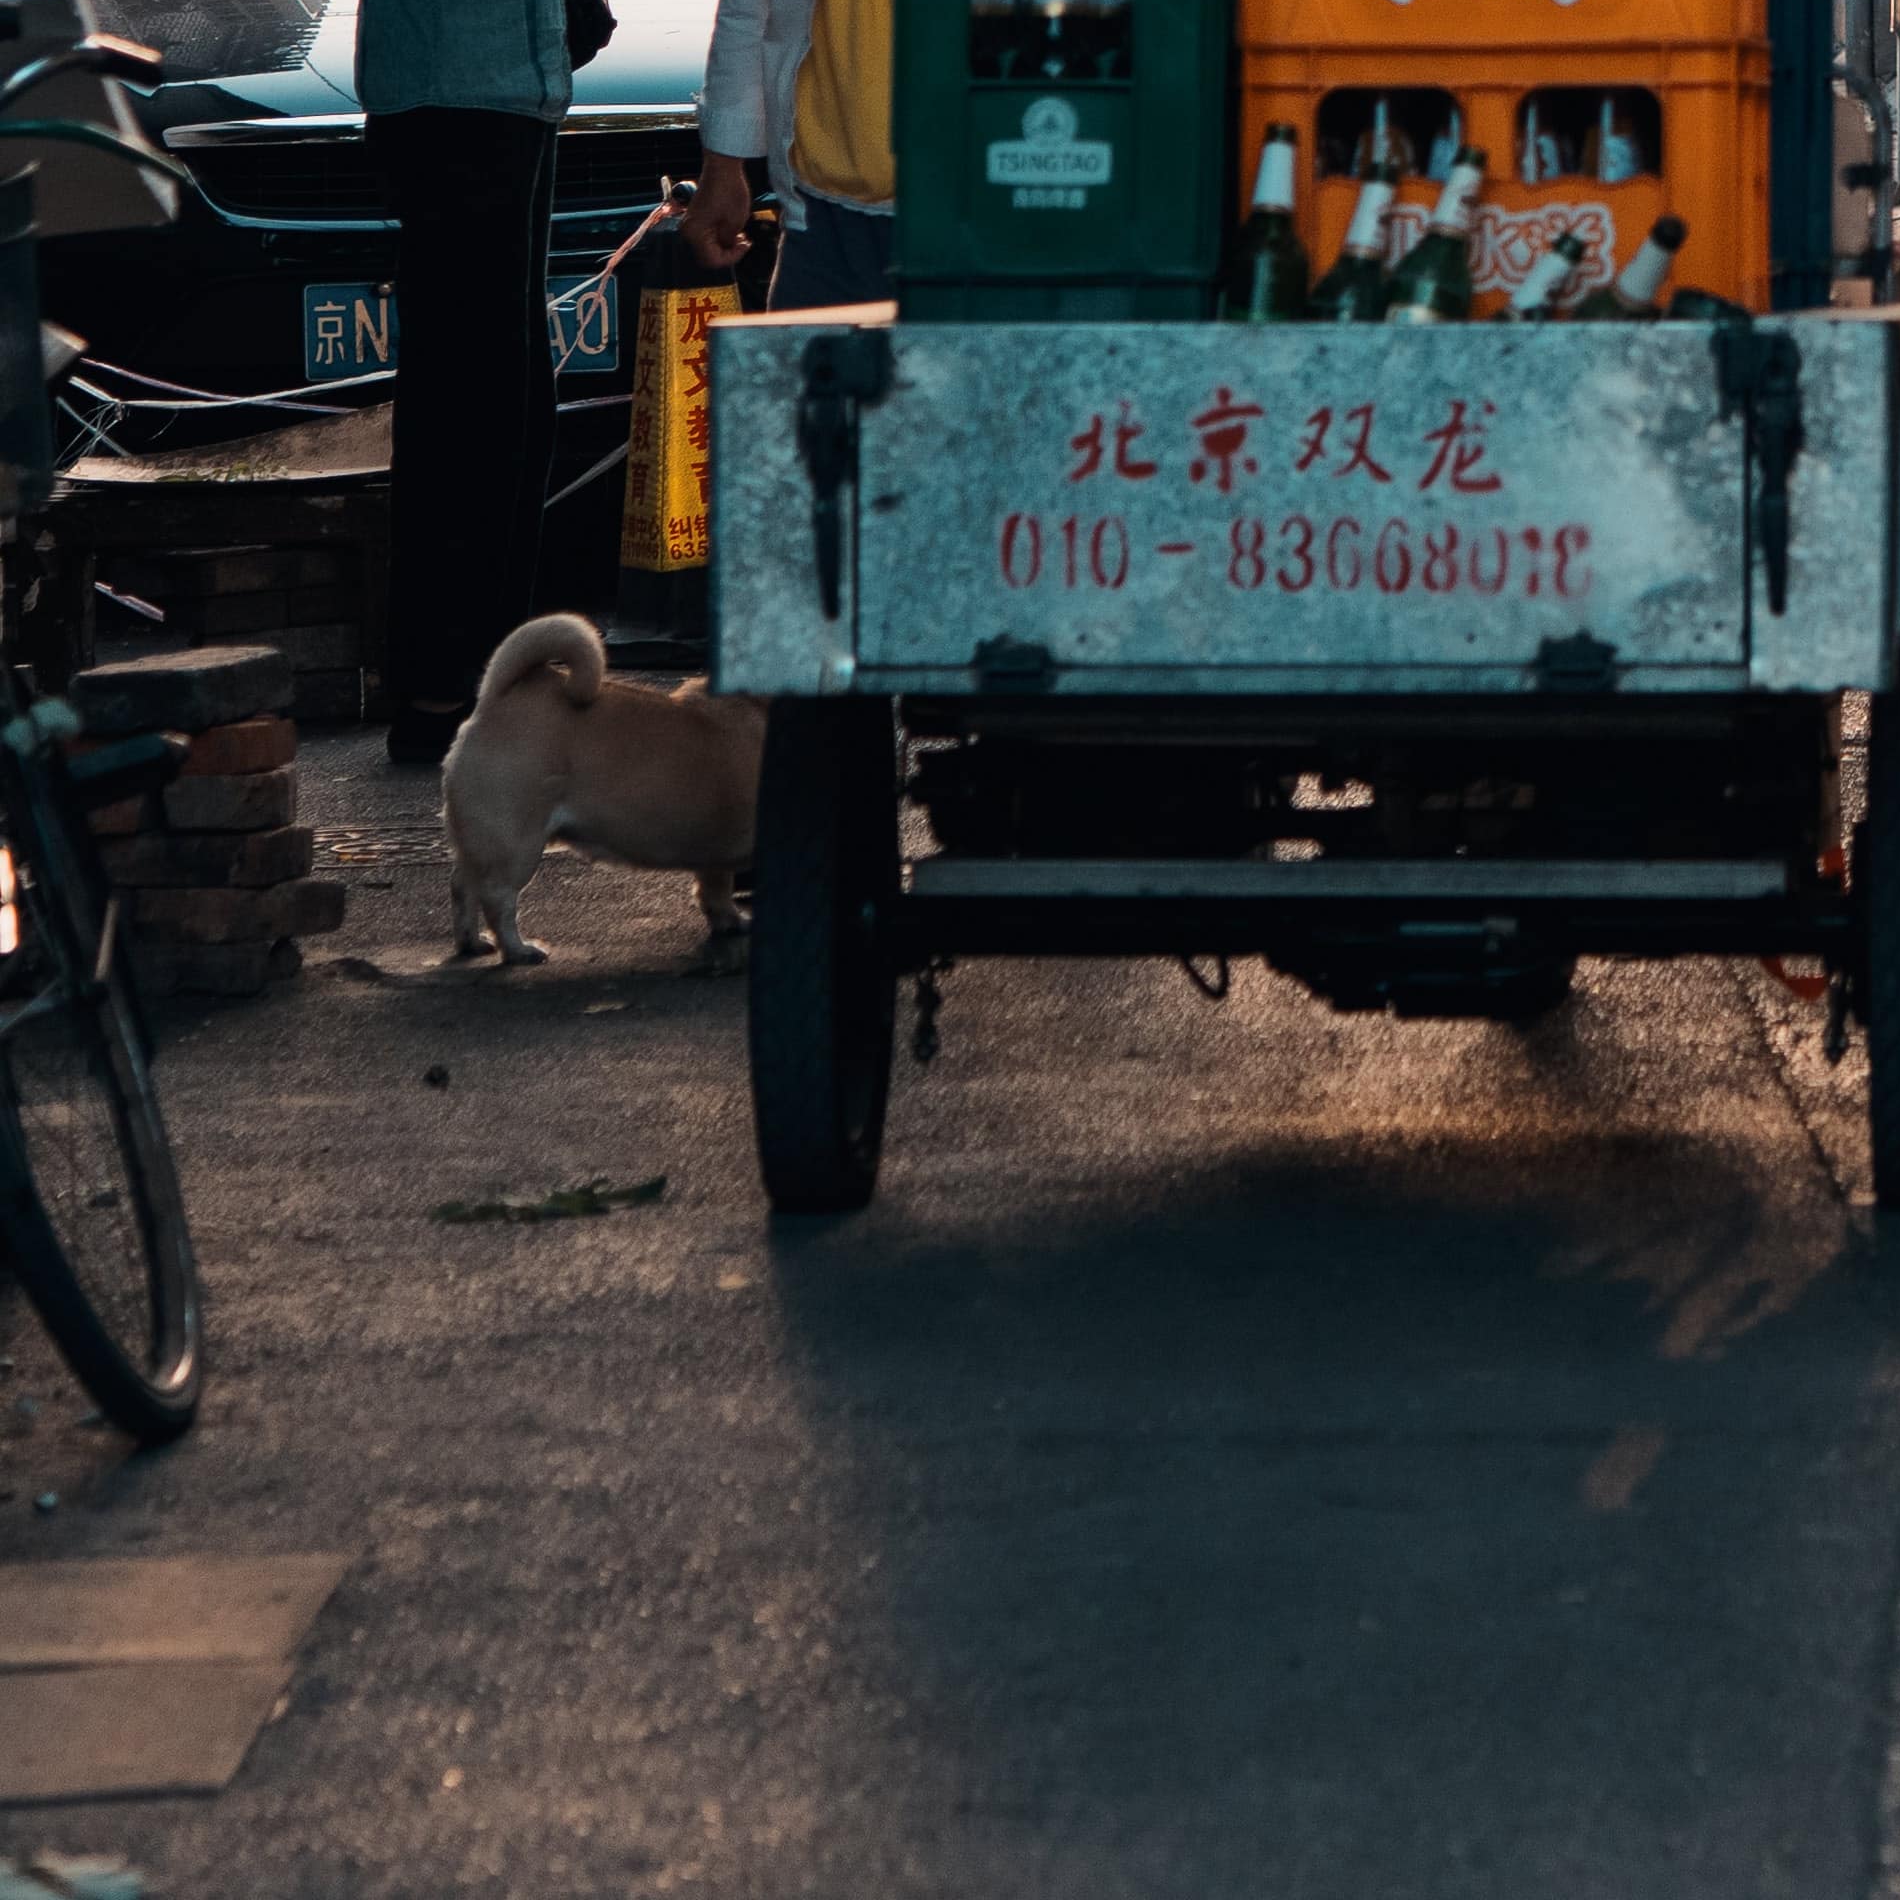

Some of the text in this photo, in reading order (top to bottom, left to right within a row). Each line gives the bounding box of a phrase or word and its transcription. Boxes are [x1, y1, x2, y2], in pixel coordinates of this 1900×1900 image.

[998, 152, 1100, 174] TSINGTAO
[1068, 385, 1504, 494] 北京双龙
